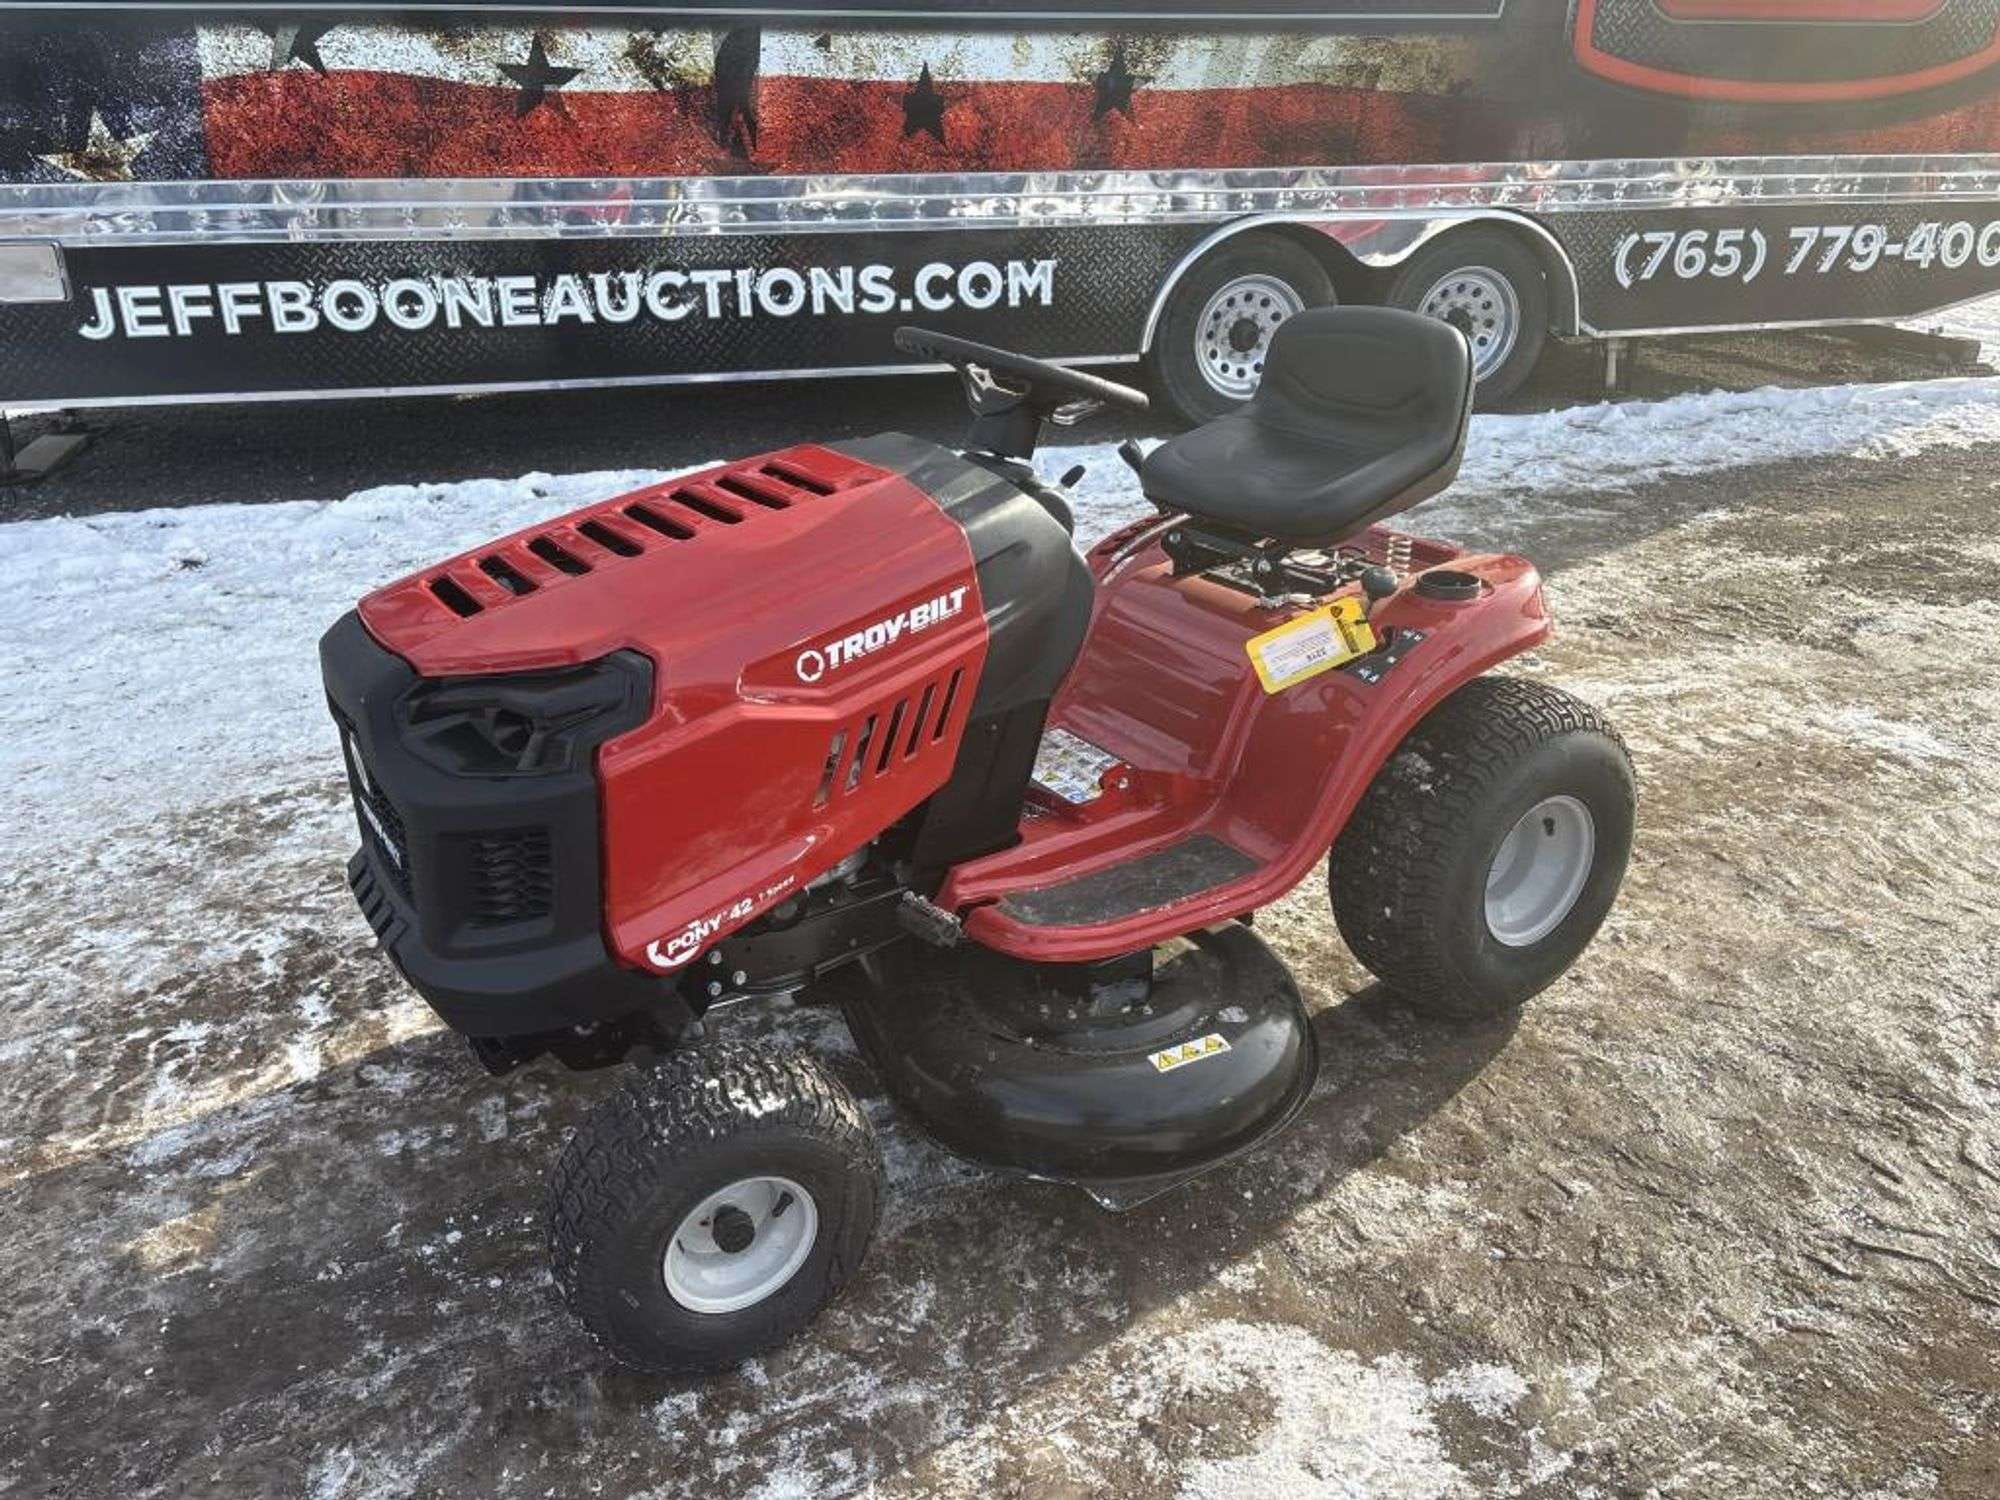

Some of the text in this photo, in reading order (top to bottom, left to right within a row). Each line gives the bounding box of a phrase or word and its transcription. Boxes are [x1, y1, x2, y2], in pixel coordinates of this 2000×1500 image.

[1614, 227, 1767, 290] (765)
[79, 260, 1056, 340] JEFFBOONEAUCTIONS.COM
[824, 586, 968, 669] TROY-BILT
[668, 913, 722, 956] PONY
[730, 898, 754, 920] 42
